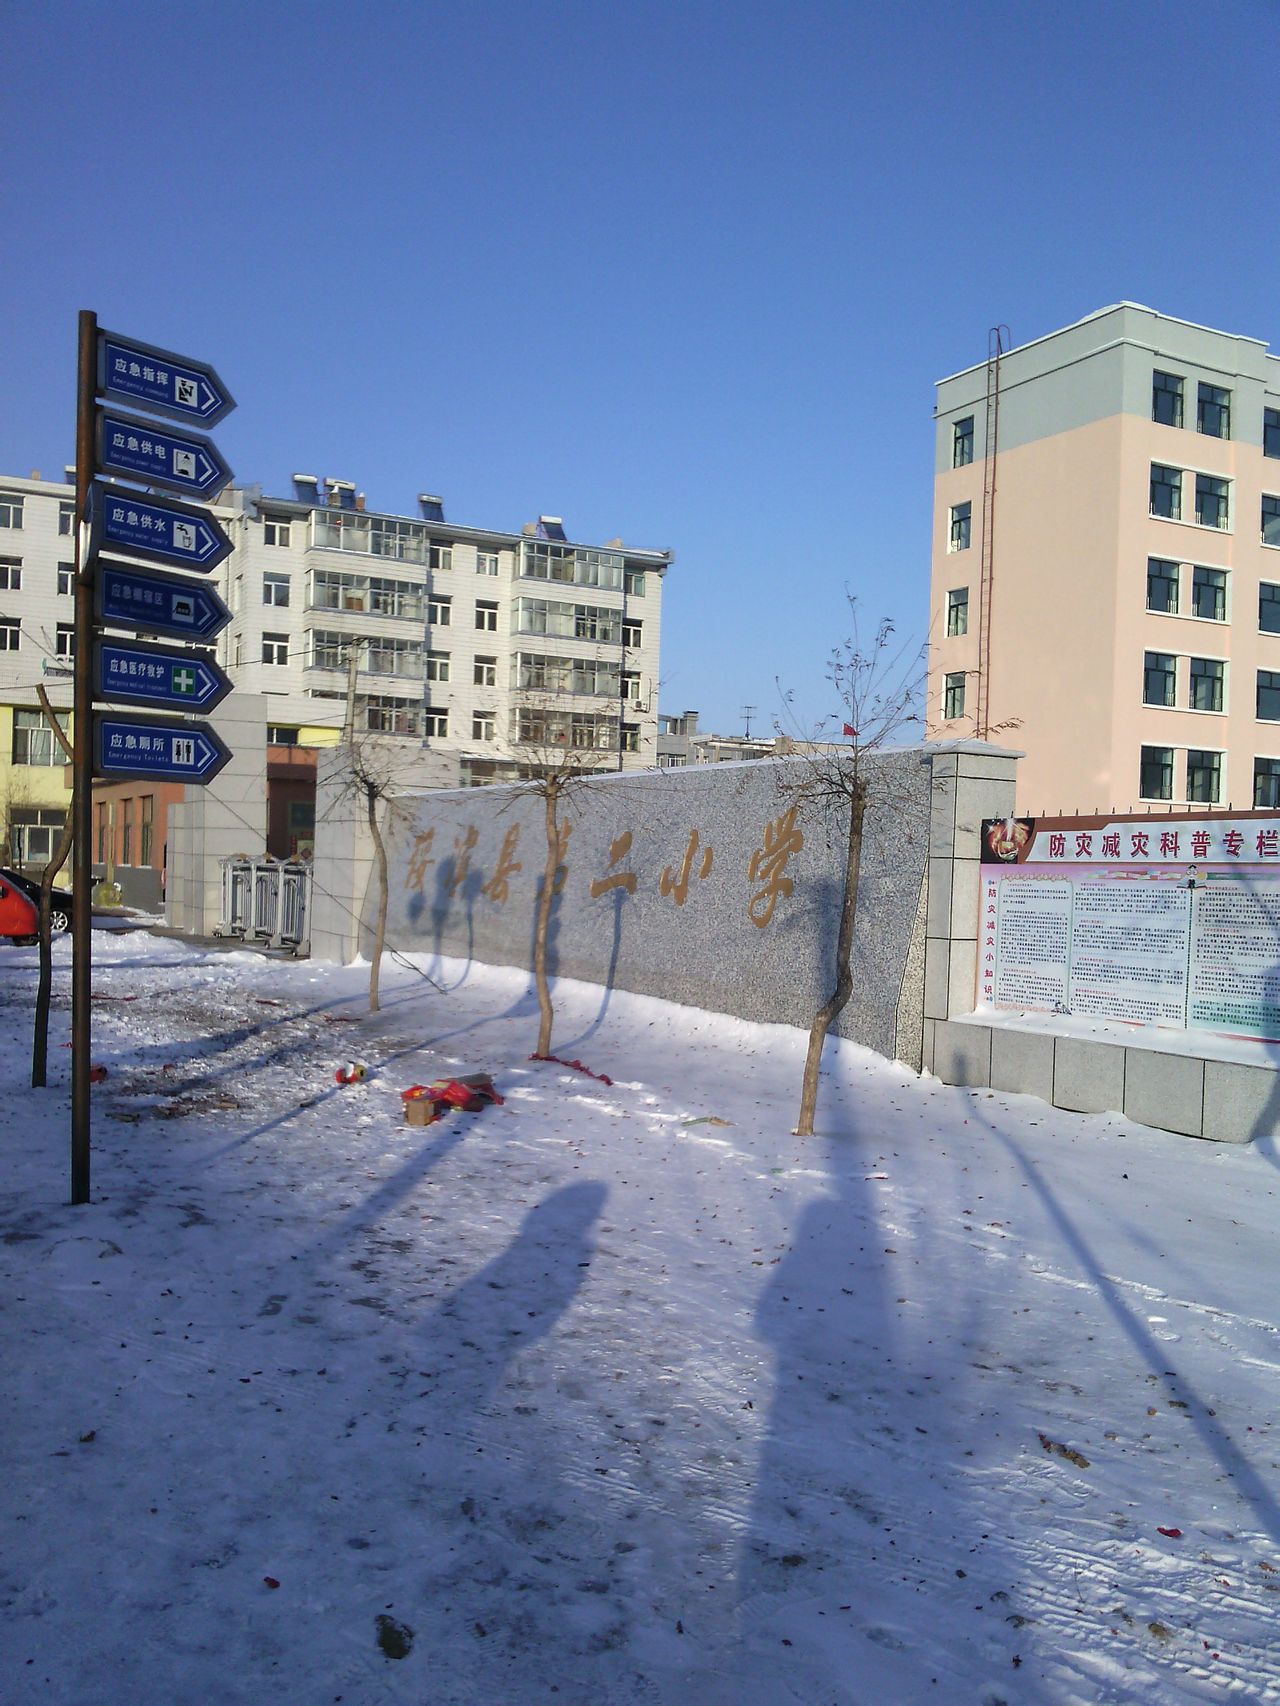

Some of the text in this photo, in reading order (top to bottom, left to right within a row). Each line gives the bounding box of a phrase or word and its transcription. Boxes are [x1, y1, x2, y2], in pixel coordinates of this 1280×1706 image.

[114, 357, 169, 386] 应急指挥
[112, 432, 167, 460] 应急供电
[112, 507, 167, 532] 应急供水
[110, 658, 165, 678] 应急医疗救护
[110, 733, 165, 752] 应急厕所
[1049, 828, 1280, 858] 防灾减灾科普专栏
[984, 888, 997, 995] 防灾减灾小知识
